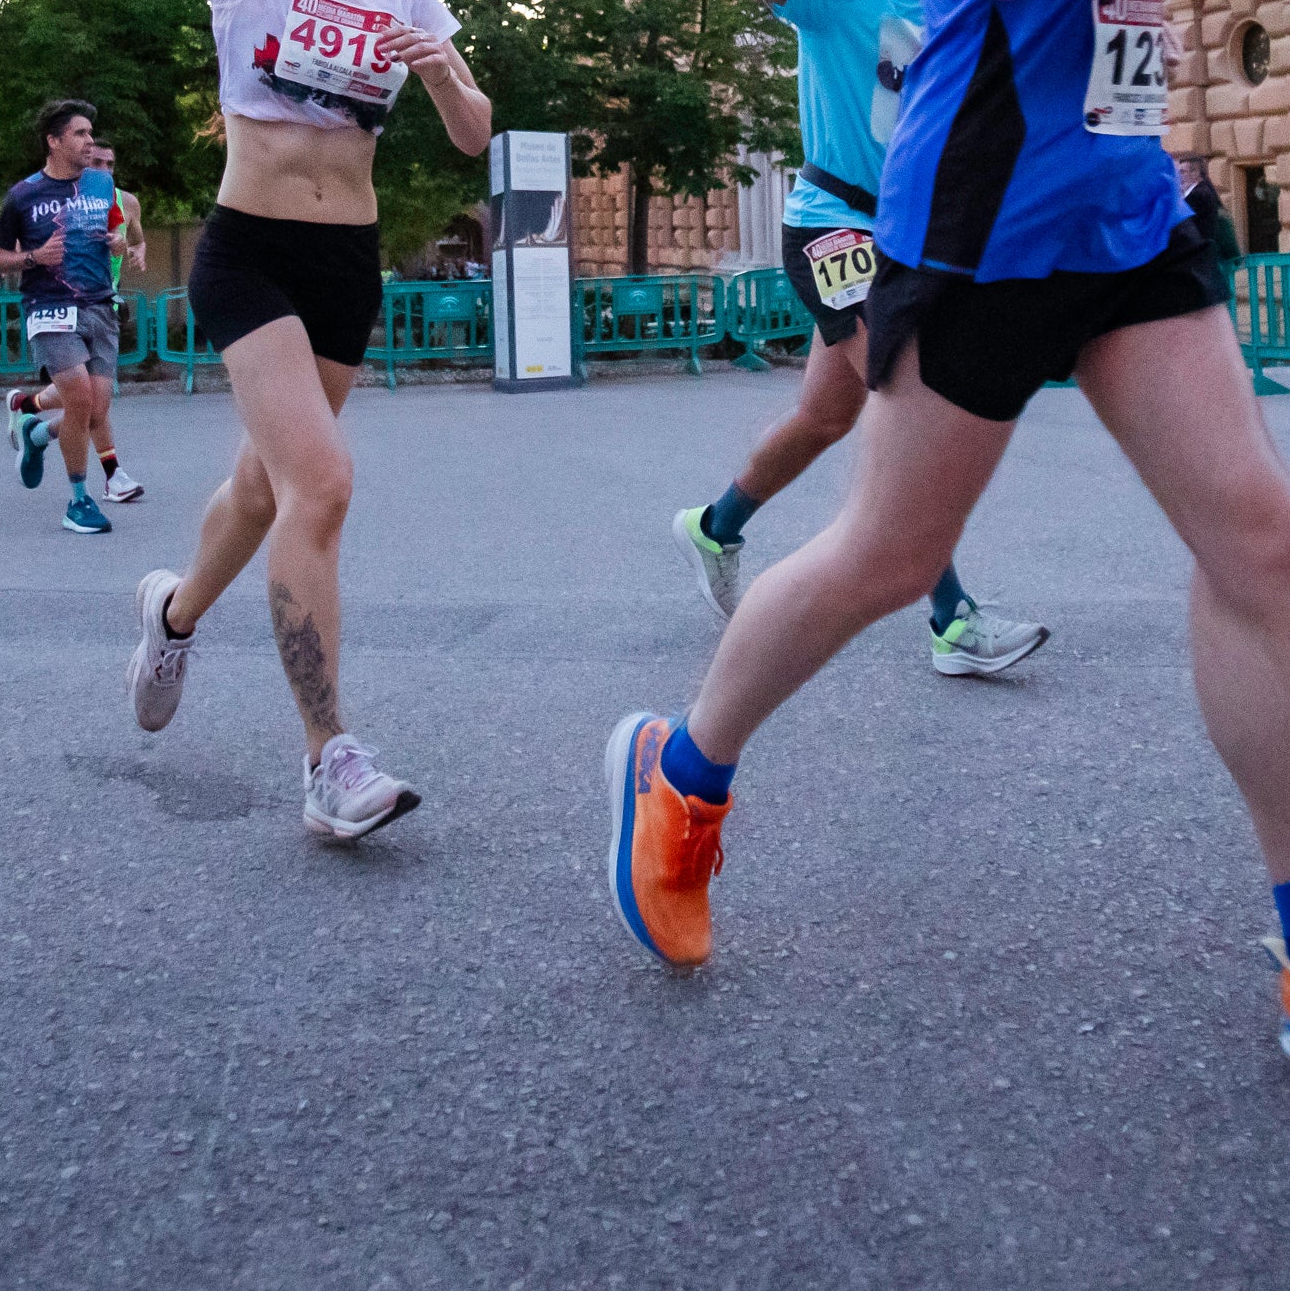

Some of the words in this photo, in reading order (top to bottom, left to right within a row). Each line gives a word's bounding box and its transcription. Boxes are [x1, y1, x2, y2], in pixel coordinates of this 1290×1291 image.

[290, 19, 392, 73] 4919
[32, 199, 61, 222] 100
[818, 247, 872, 288] 170
